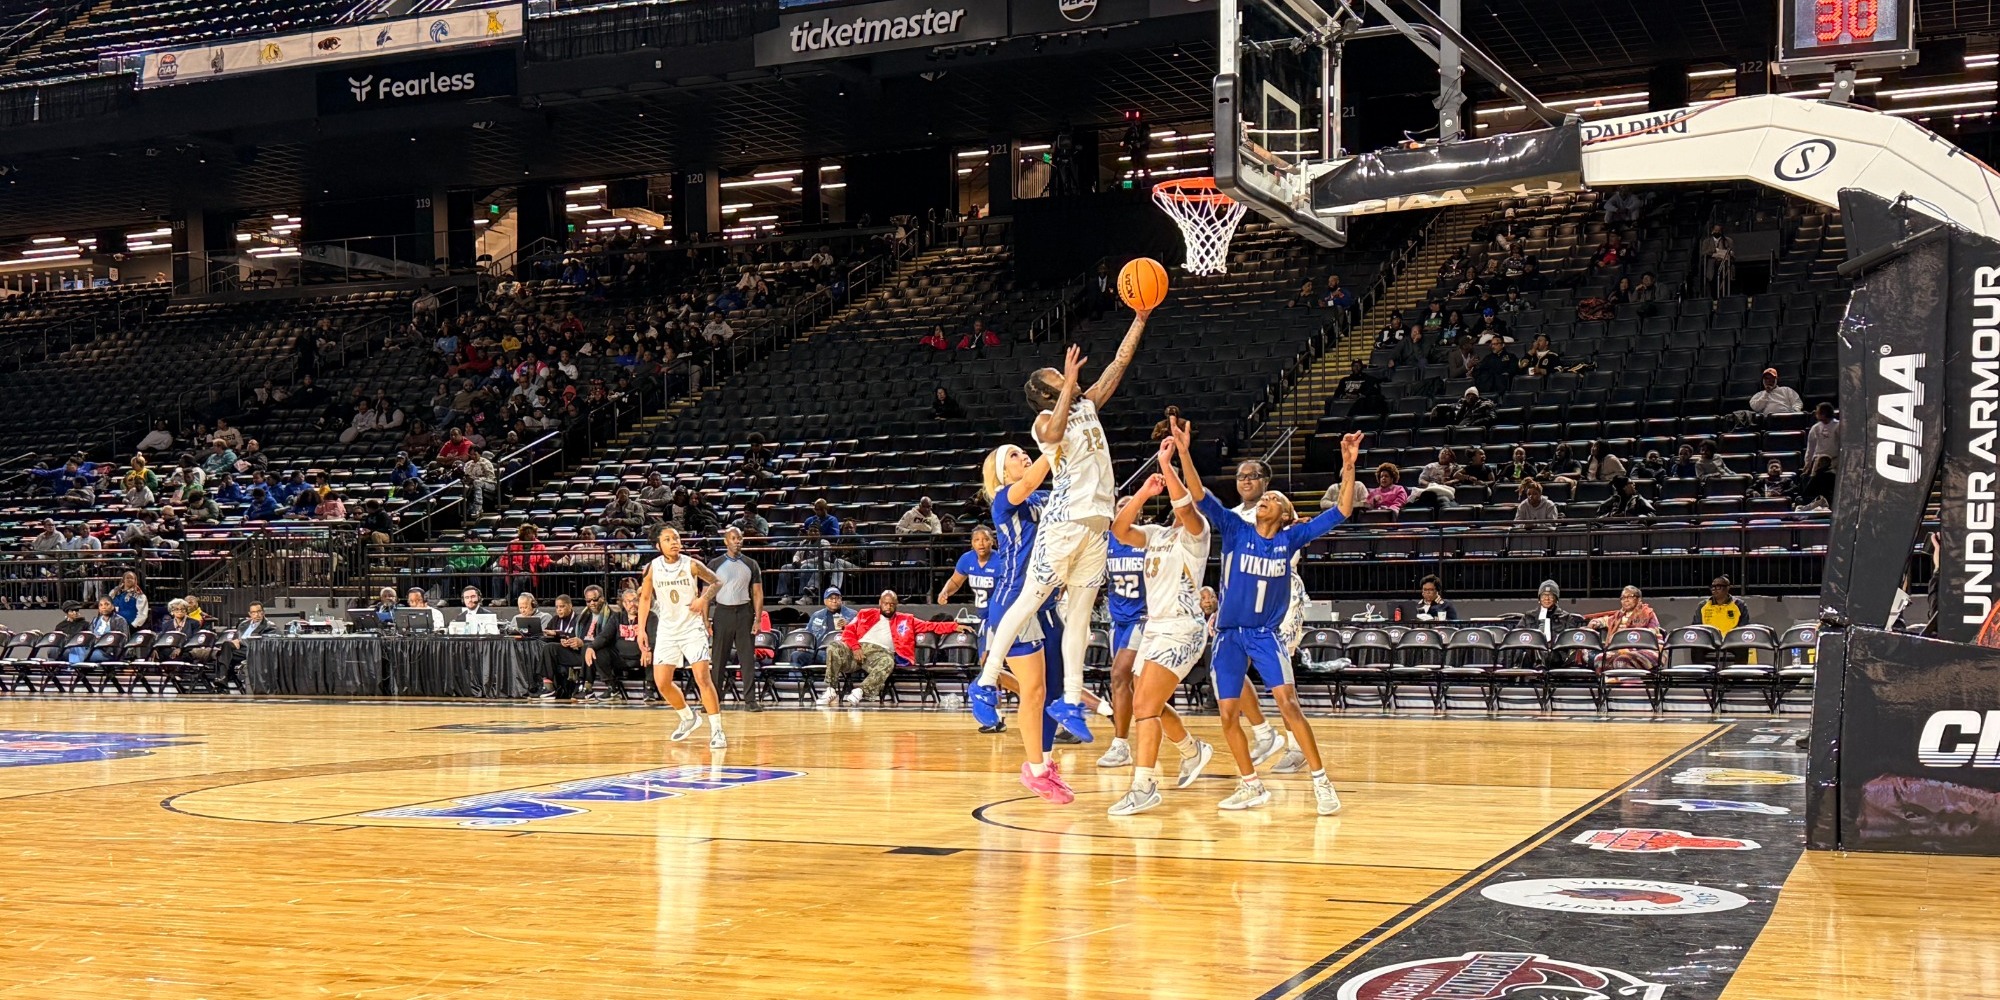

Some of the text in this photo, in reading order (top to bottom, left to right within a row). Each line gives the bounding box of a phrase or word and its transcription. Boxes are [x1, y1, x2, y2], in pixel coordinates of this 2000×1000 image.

[790, 8, 965, 52] ticketmaster
[1814, 0, 1879, 42] 30
[1739, 61, 1763, 74] 122
[378, 72, 475, 100] Fearless
[1342, 106, 1356, 117] 21
[1582, 109, 1688, 146] PALDING
[687, 173, 704, 184] 120
[416, 198, 431, 208] 119
[172, 220, 185, 230] 118
[1875, 352, 1927, 484] CIAA
[1082, 427, 1105, 452] 12
[1962, 266, 2000, 624] UNDER ARMOUR
[1107, 556, 1144, 572] VIKINGS
[1240, 553, 1287, 578] VIKINGS
[669, 589, 680, 605] 0
[1112, 574, 1140, 599] 22
[1254, 579, 1268, 613] 1
[1918, 710, 2000, 768] CI
